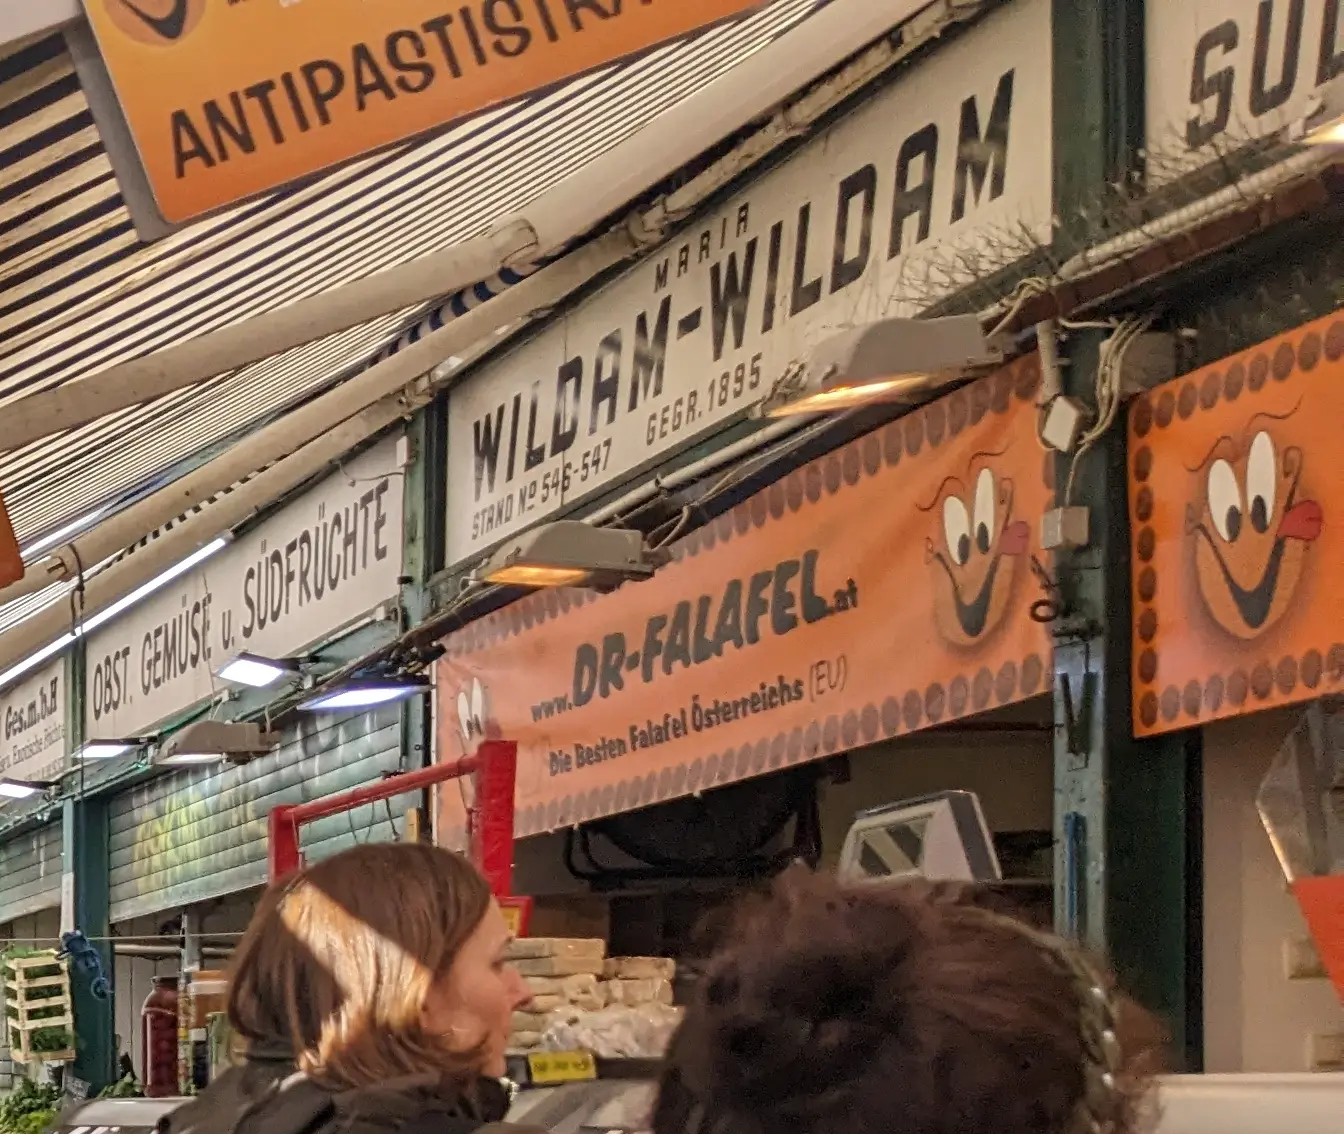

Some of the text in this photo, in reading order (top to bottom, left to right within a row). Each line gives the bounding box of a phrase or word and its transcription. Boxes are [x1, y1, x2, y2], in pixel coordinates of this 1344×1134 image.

[472, 66, 1015, 503] WILDAM-WILDAM
[654, 201, 751, 293] MARIA
[646, 351, 763, 447] GEGR. 1895
[471, 493, 514, 541] STAND
[541, 437, 612, 504] 546-547
[140, 591, 213, 697] GEMÜSE
[242, 477, 390, 640] SÜDFRÜCHTE
[530, 549, 859, 723] www.DR-FALAFEL.at
[549, 654, 849, 778] Die Besten Falafel Österreichs (EU)
